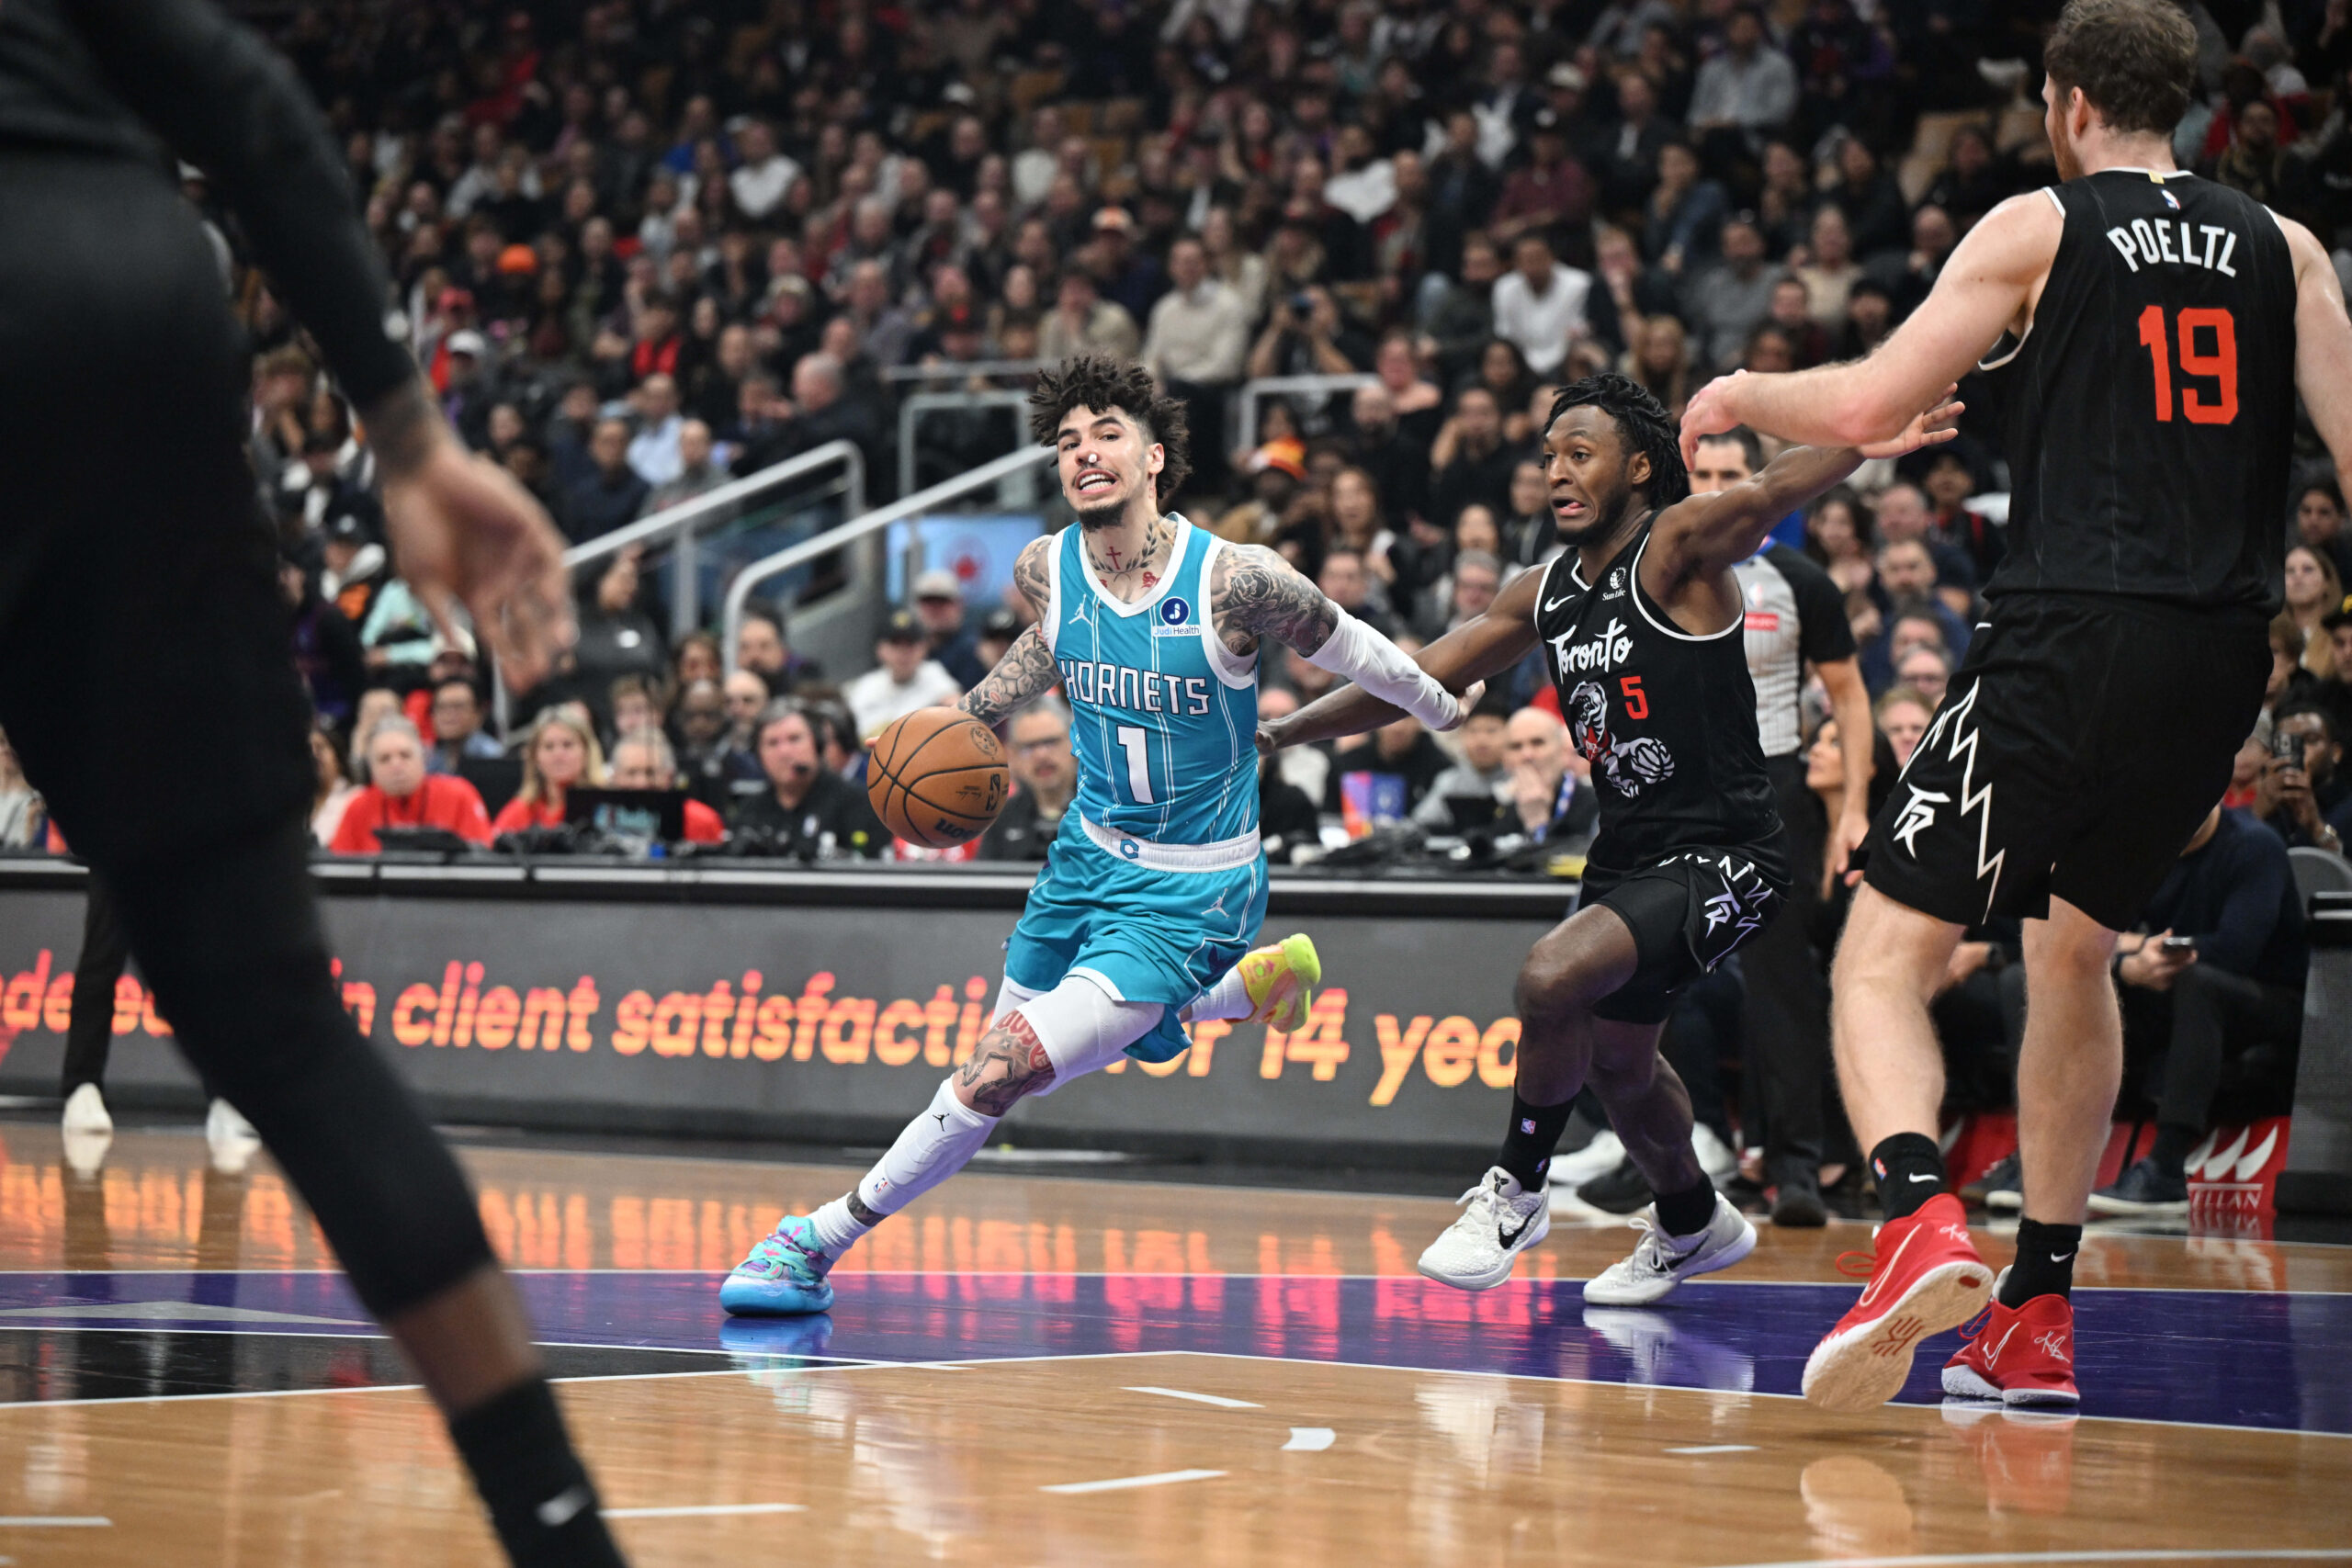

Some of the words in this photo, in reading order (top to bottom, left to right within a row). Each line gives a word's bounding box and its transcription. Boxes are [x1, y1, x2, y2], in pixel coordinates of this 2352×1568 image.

[2107, 218, 2236, 277] POELTL
[2138, 305, 2238, 424] 19
[1601, 592, 1614, 601] Sun
[1614, 588, 1626, 598] Life
[1154, 626, 1172, 636] Judi
[1173, 626, 1200, 635] Health
[1546, 617, 1633, 684] Toronto
[1059, 659, 1212, 716] HORNETS
[1620, 675, 1649, 720] 5
[1116, 725, 1155, 805] 1
[392, 960, 600, 1052] client
[611, 969, 998, 1067] satisfacti
[1260, 987, 1351, 1081] 14
[1369, 1013, 1522, 1107] yea
